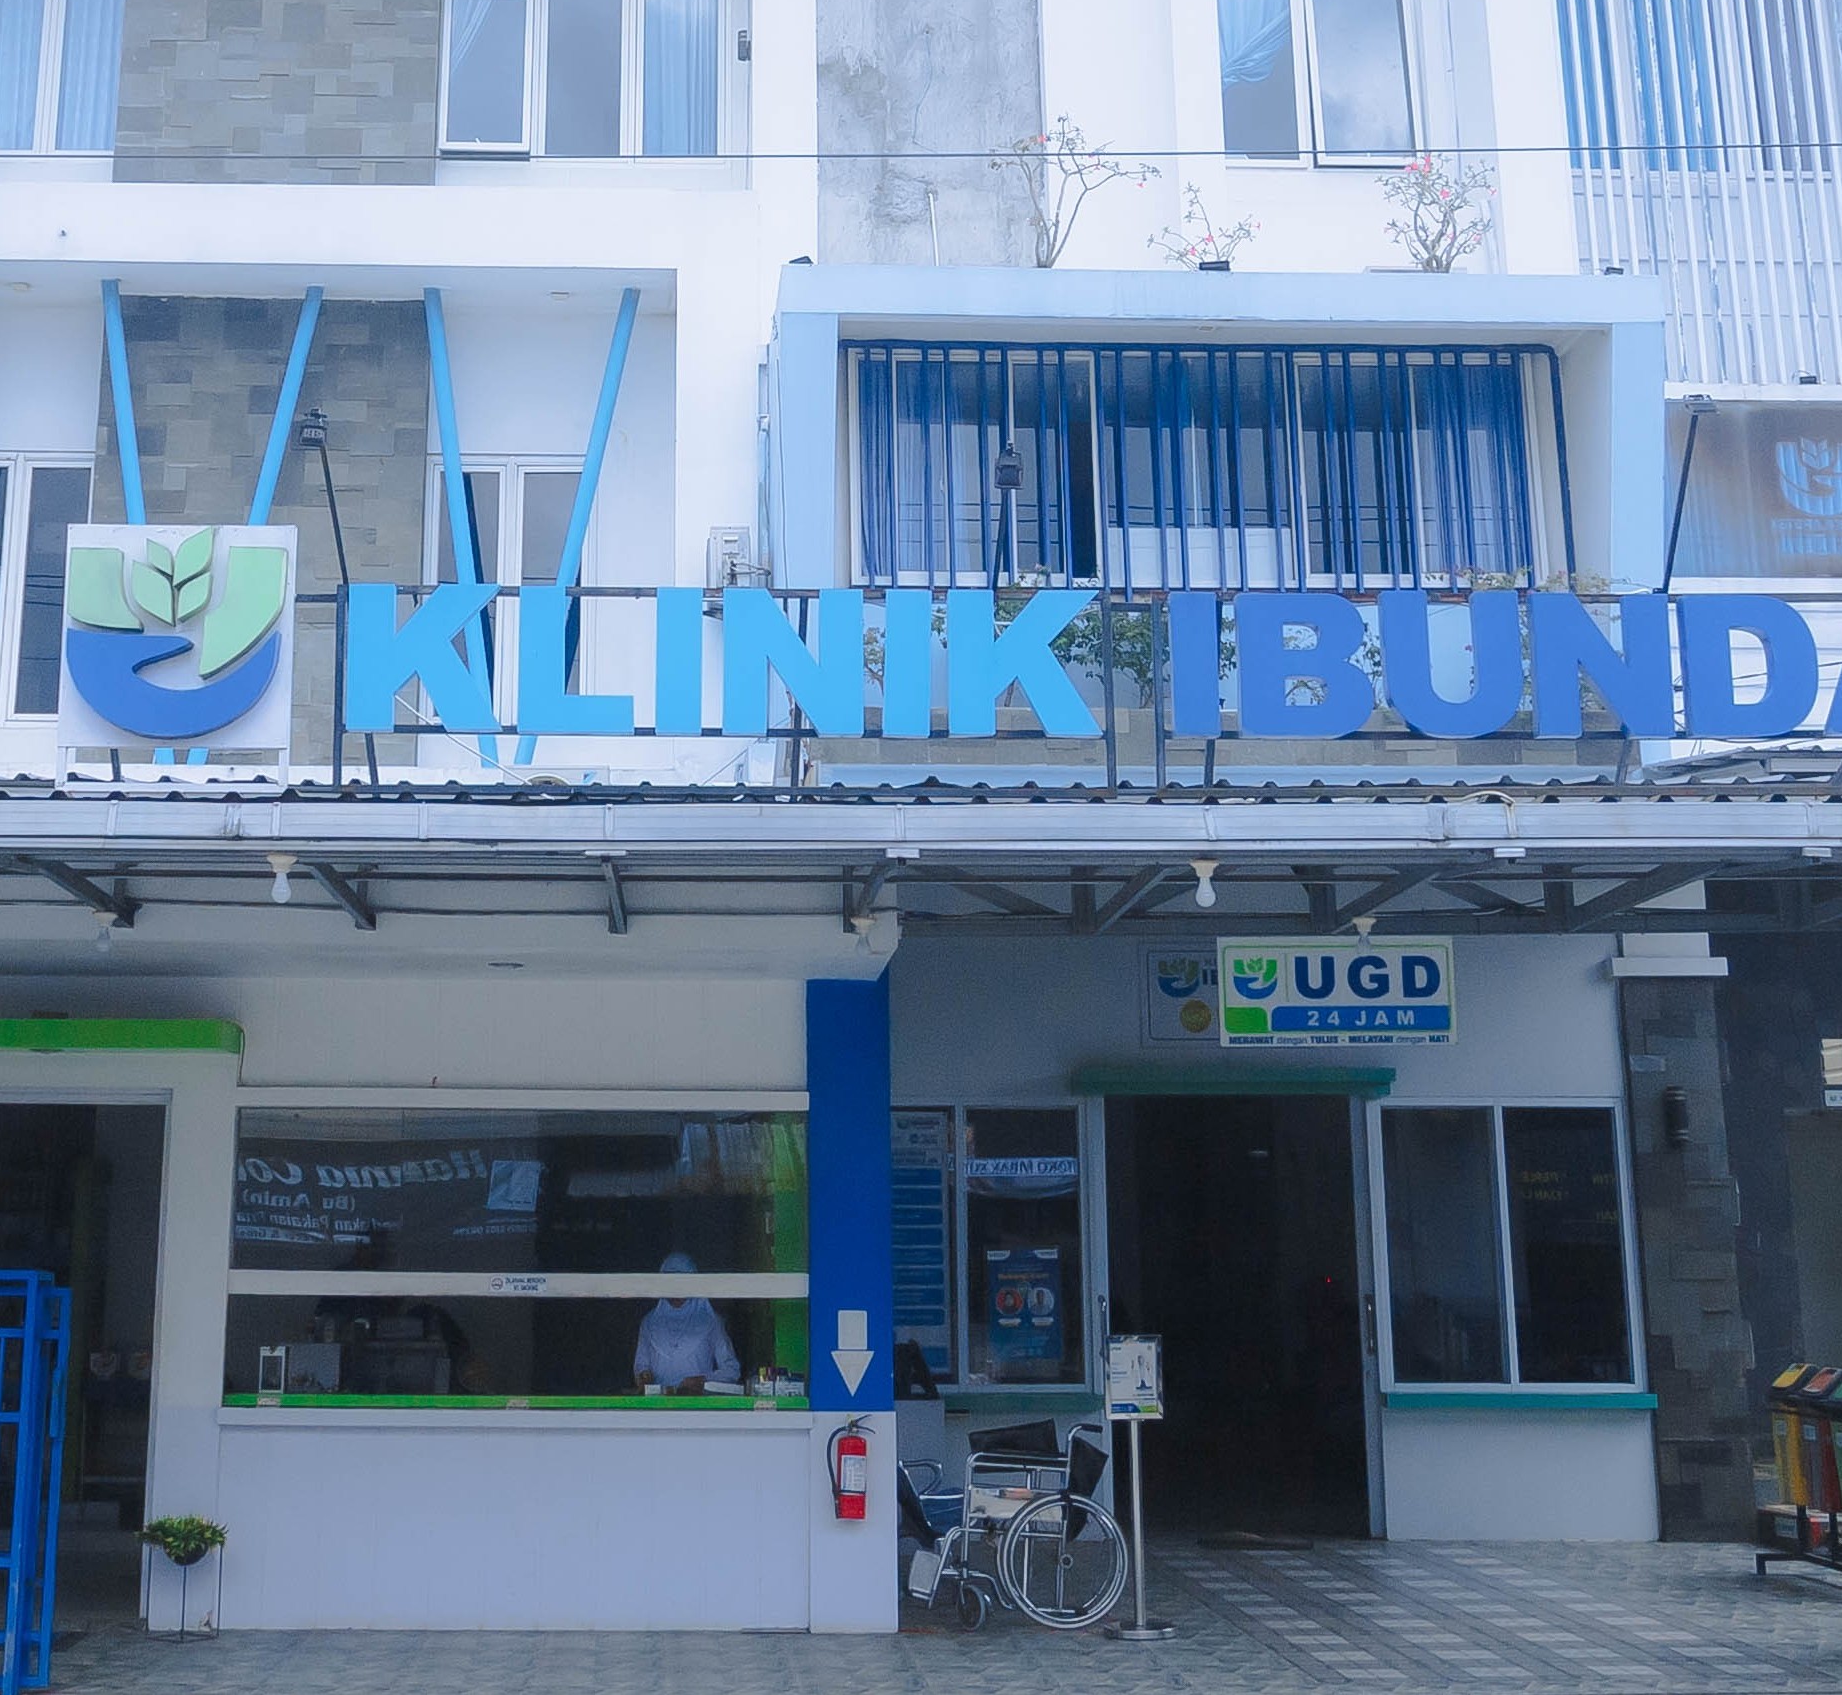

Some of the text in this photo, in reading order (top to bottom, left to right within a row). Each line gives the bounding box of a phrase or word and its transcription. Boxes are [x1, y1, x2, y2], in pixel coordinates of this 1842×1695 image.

[346, 583, 1104, 738] KLINIK
[1294, 955, 1441, 999] UGD
[1307, 1010, 1415, 1027] 24 JAM
[1229, 1035, 1274, 1045] MERAWAT
[1310, 1035, 1338, 1045] TULUS
[1349, 1034, 1394, 1044] MELAYANI
[1429, 1034, 1450, 1044] HATI
